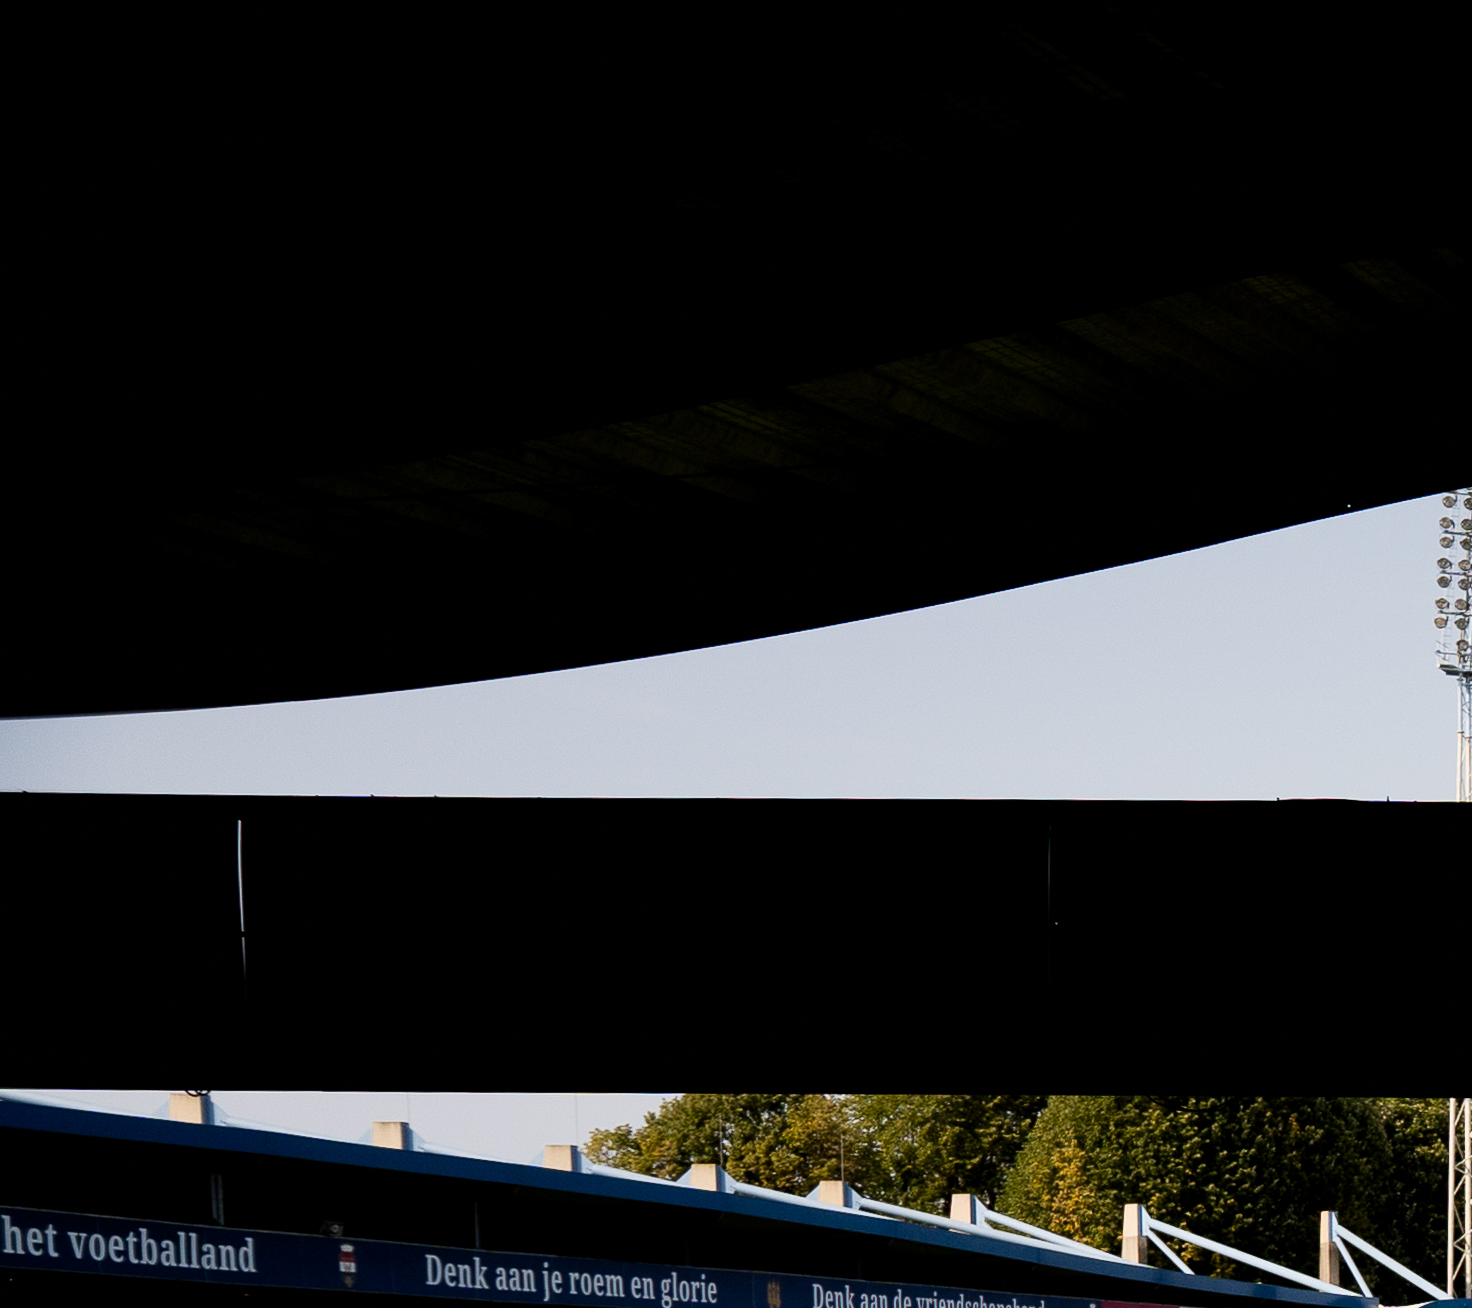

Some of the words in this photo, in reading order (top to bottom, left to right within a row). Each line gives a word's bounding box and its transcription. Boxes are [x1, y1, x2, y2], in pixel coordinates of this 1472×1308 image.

[2, 1216, 57, 1258] het
[68, 1228, 256, 1273] voetballand
[425, 1255, 489, 1290] Denk
[496, 1266, 536, 1292] aan
[542, 1262, 562, 1301] je
[569, 1275, 625, 1297] roem
[631, 1279, 655, 1300] en
[660, 1272, 717, 1308] glorie
